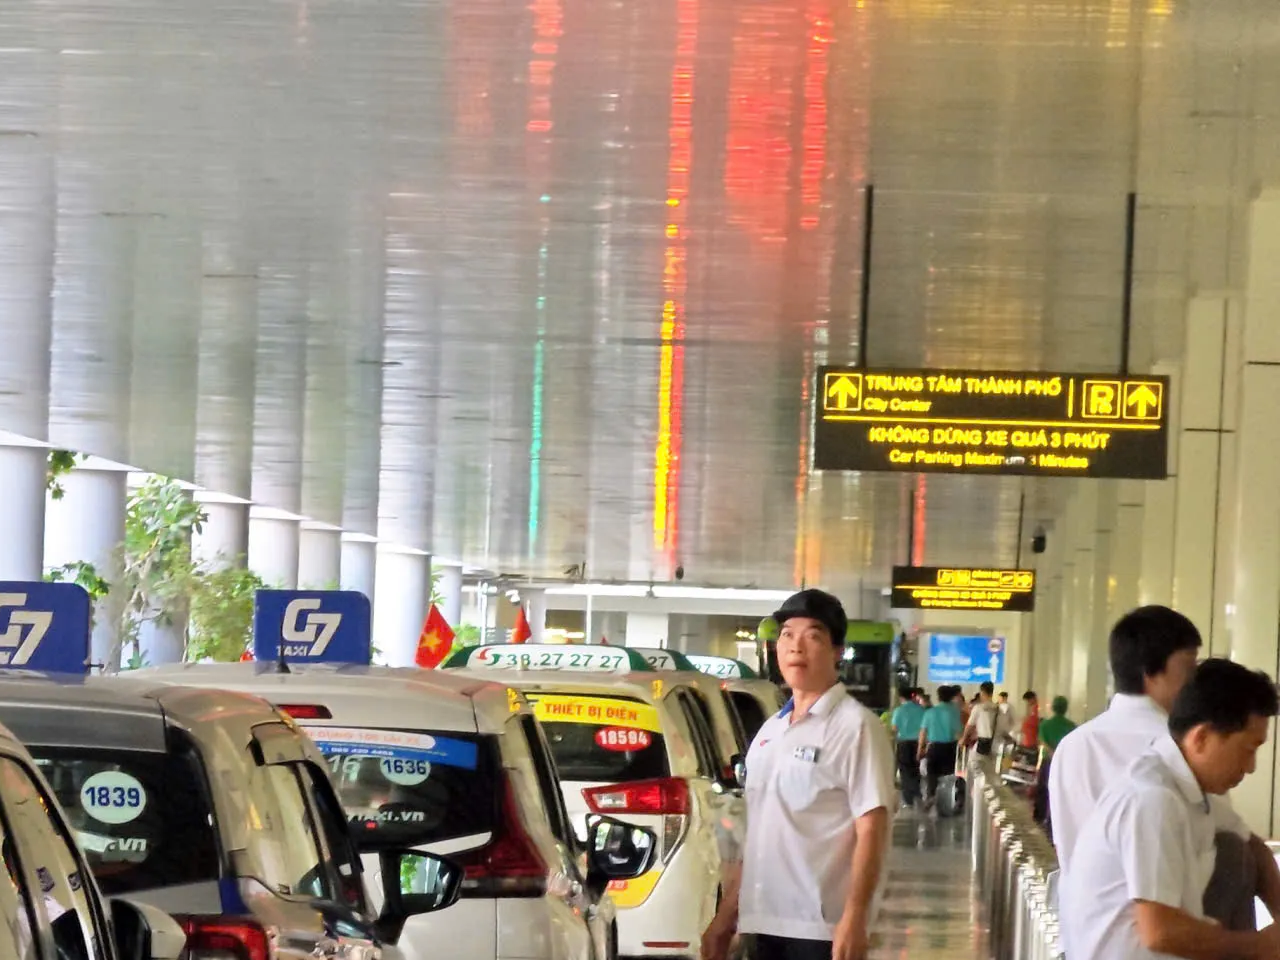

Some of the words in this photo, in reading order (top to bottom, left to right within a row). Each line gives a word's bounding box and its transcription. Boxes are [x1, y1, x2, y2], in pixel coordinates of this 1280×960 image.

[865, 375, 924, 392] TRUNG
[927, 375, 962, 393] TÂM
[965, 376, 1022, 395] THÀNH
[864, 397, 888, 412] City
[890, 398, 932, 412] Center
[869, 425, 930, 443] KHÔNG
[985, 430, 1009, 446] XE
[1050, 432, 1061, 448] 3
[1064, 431, 1111, 449] PHÚT
[889, 449, 914, 463] Car
[915, 451, 962, 466] Parking
[282, 598, 343, 656] G7
[276, 645, 309, 657] TAXI
[570, 653, 594, 668] 27
[600, 655, 624, 669] 27
[648, 656, 669, 669] 27
[716, 664, 737, 675] 27
[383, 759, 427, 775] 1636
[85, 786, 140, 808] 1839
